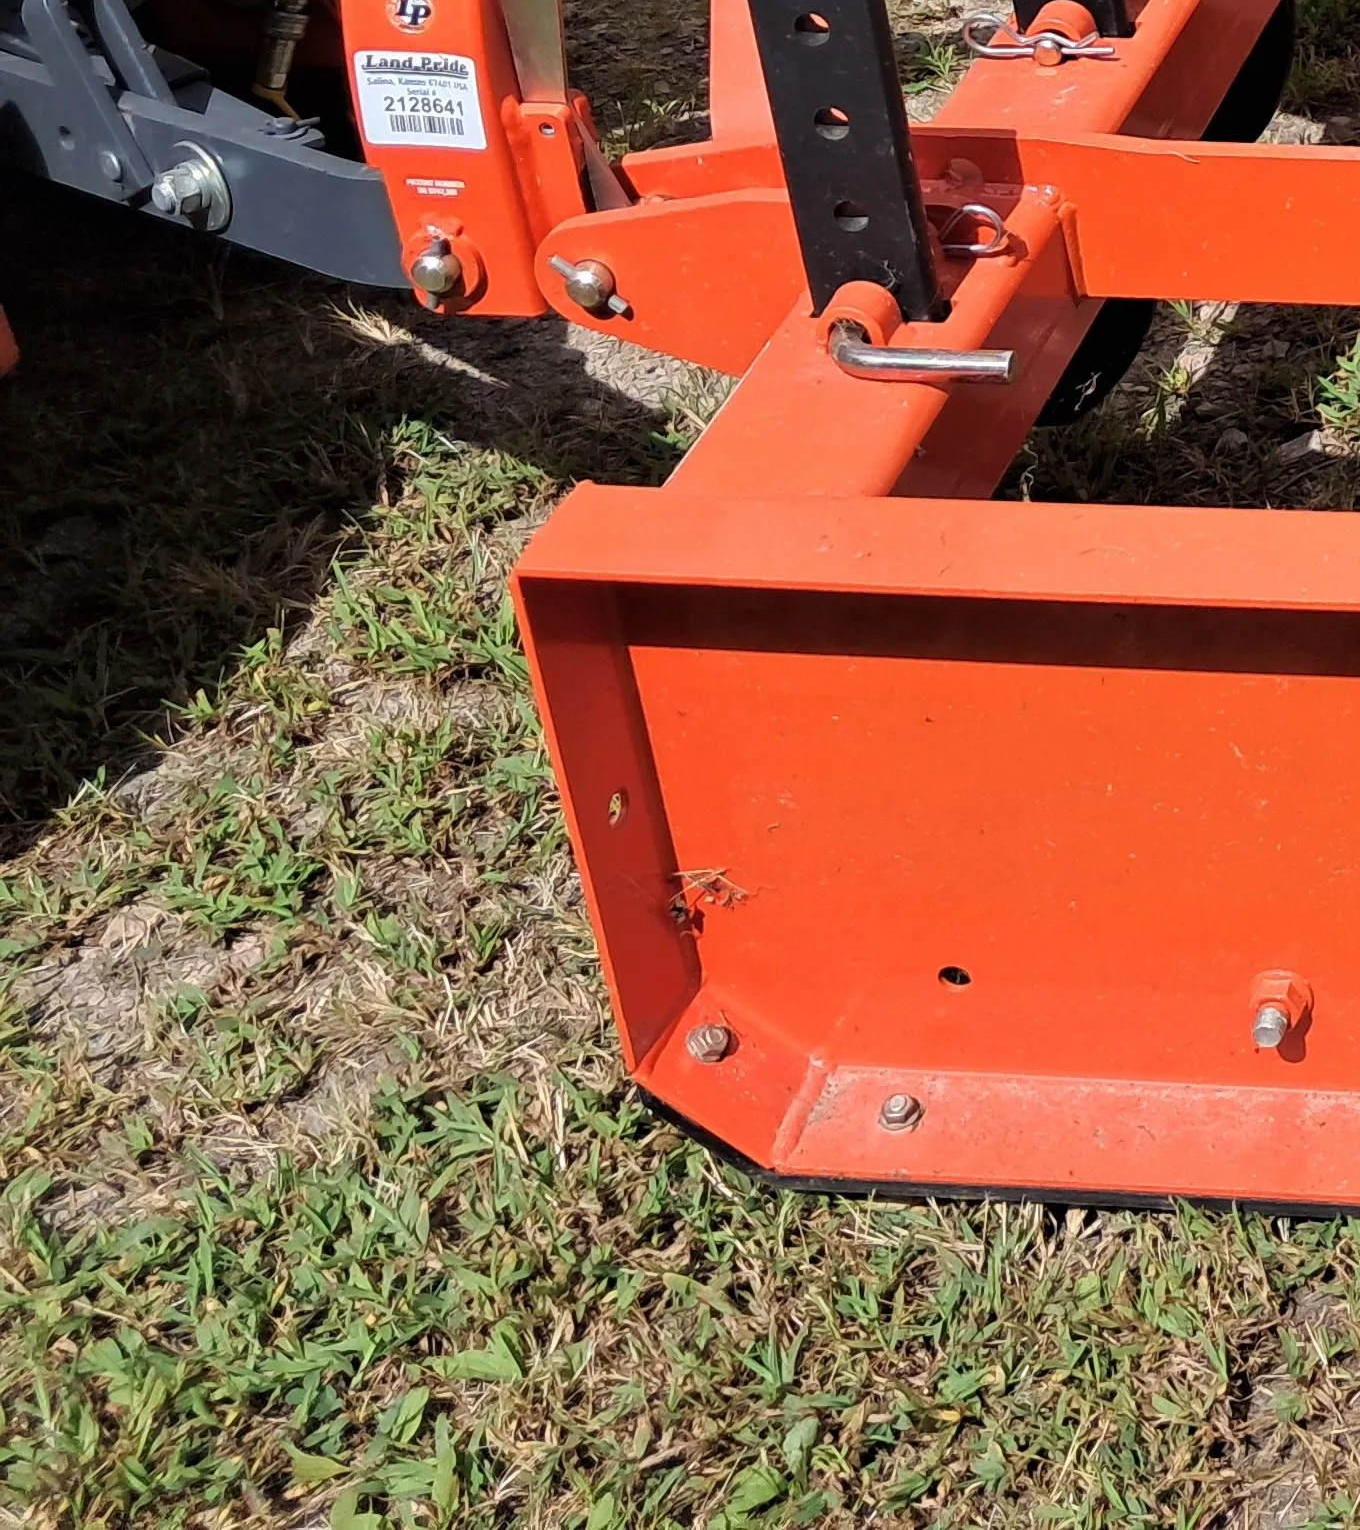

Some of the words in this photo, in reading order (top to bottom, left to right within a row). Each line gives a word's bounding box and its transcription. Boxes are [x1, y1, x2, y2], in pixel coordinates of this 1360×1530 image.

[365, 54, 414, 70] Land
[420, 56, 468, 75] Pride
[406, 87, 430, 96] Serial
[383, 96, 464, 116] 2128641
